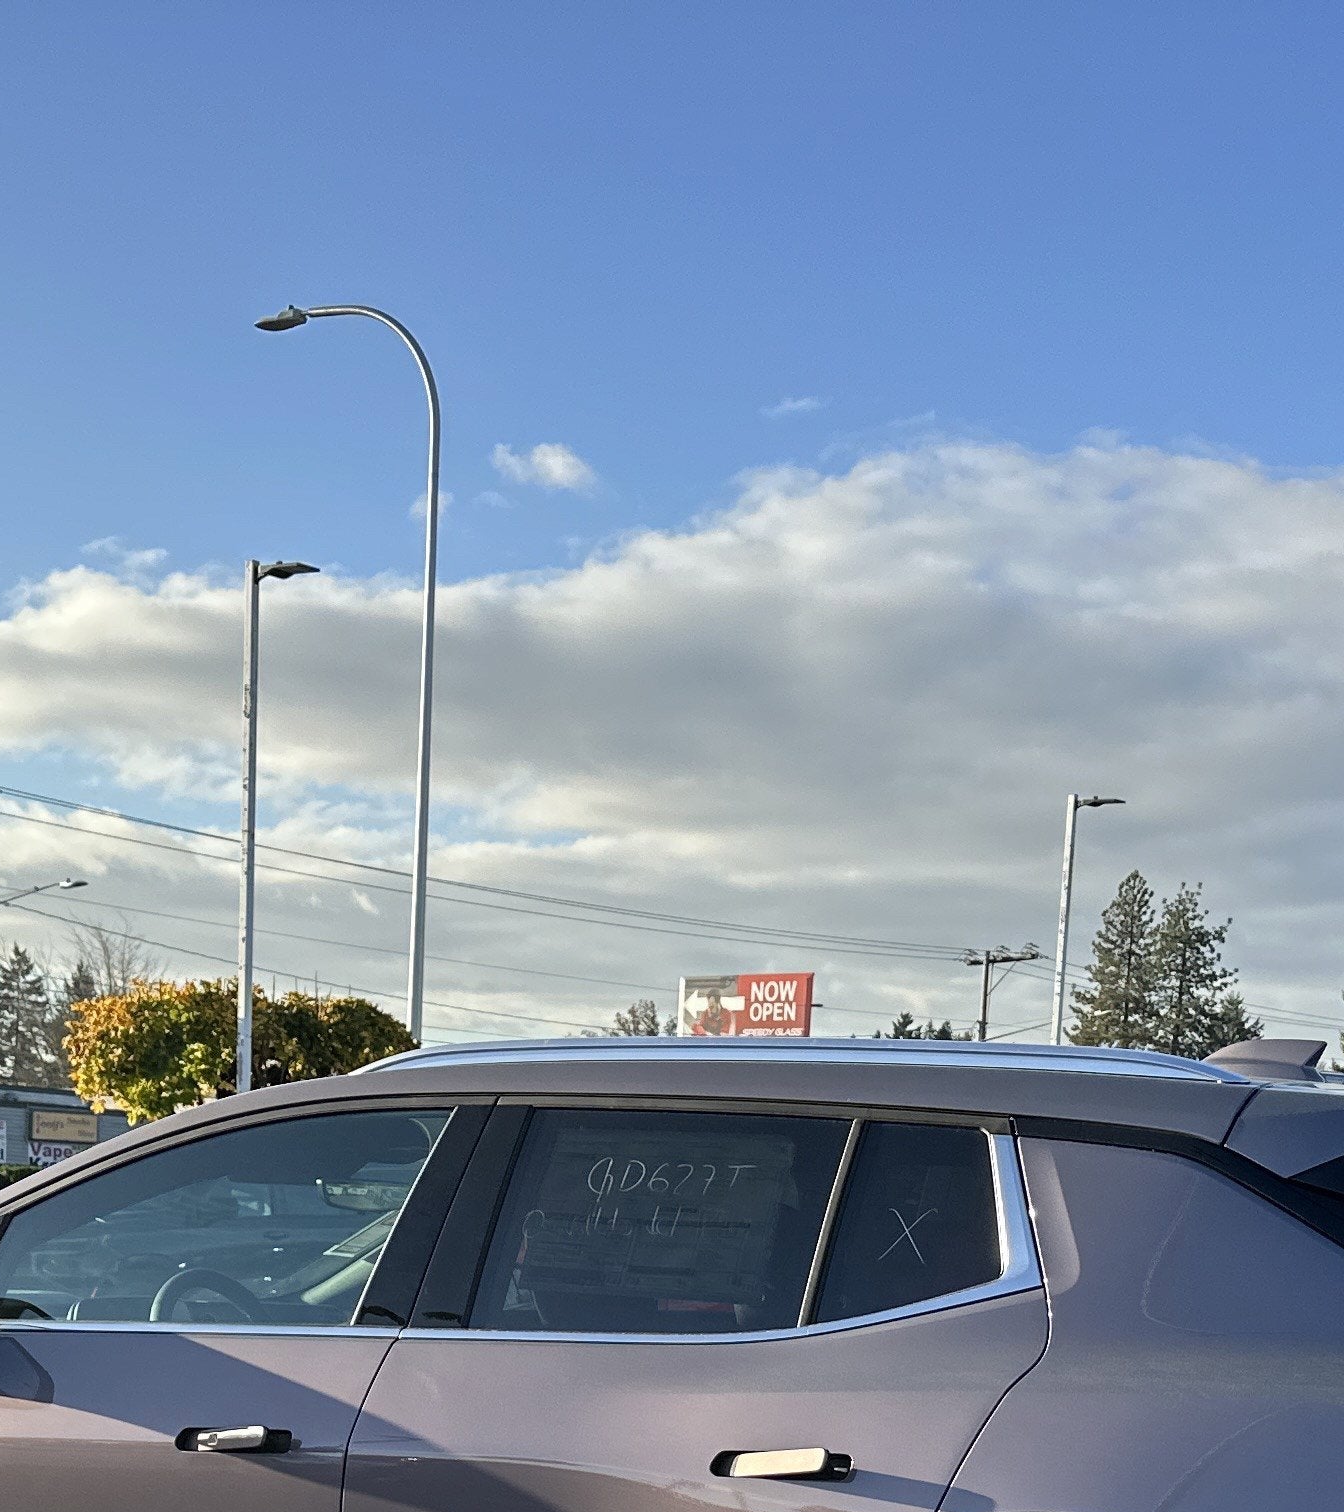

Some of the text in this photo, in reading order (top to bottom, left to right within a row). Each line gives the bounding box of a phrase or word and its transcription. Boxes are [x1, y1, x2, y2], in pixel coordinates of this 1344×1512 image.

[750, 980, 798, 1002] NOW
[749, 1002, 797, 1022] OPEN
[774, 1028, 804, 1036] GLASS
[31, 1142, 73, 1160] Vape
[877, 1207, 939, 1265] X
